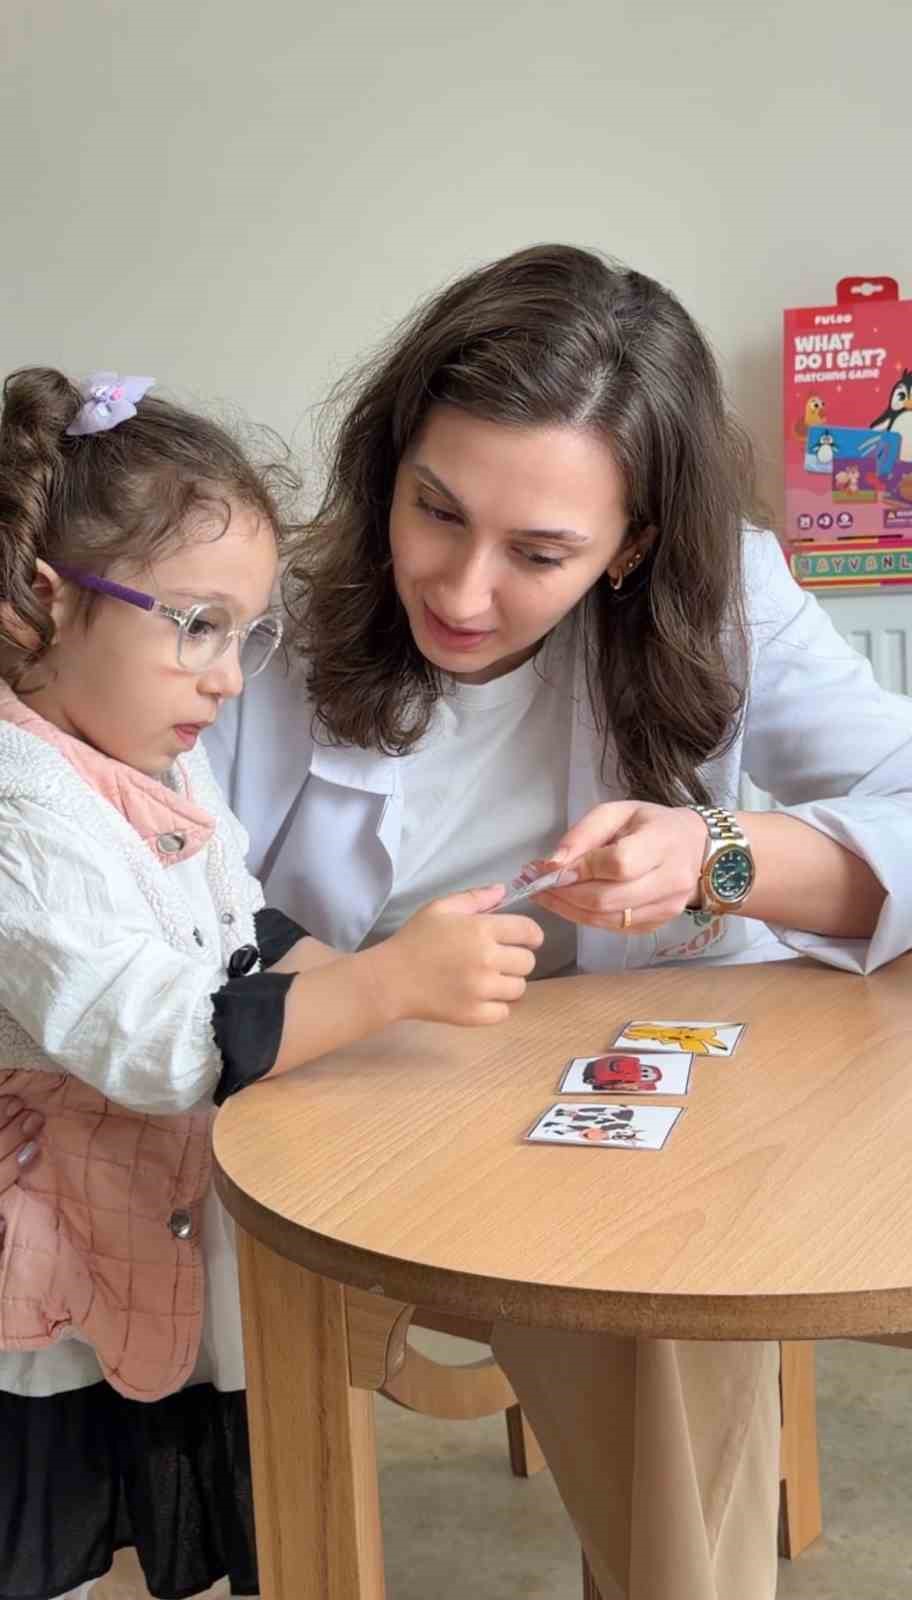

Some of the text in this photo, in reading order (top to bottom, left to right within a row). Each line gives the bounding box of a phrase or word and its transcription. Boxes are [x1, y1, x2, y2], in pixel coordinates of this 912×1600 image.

[794, 333, 854, 352] WHAT
[794, 354, 822, 371] DO
[825, 352, 833, 369] I
